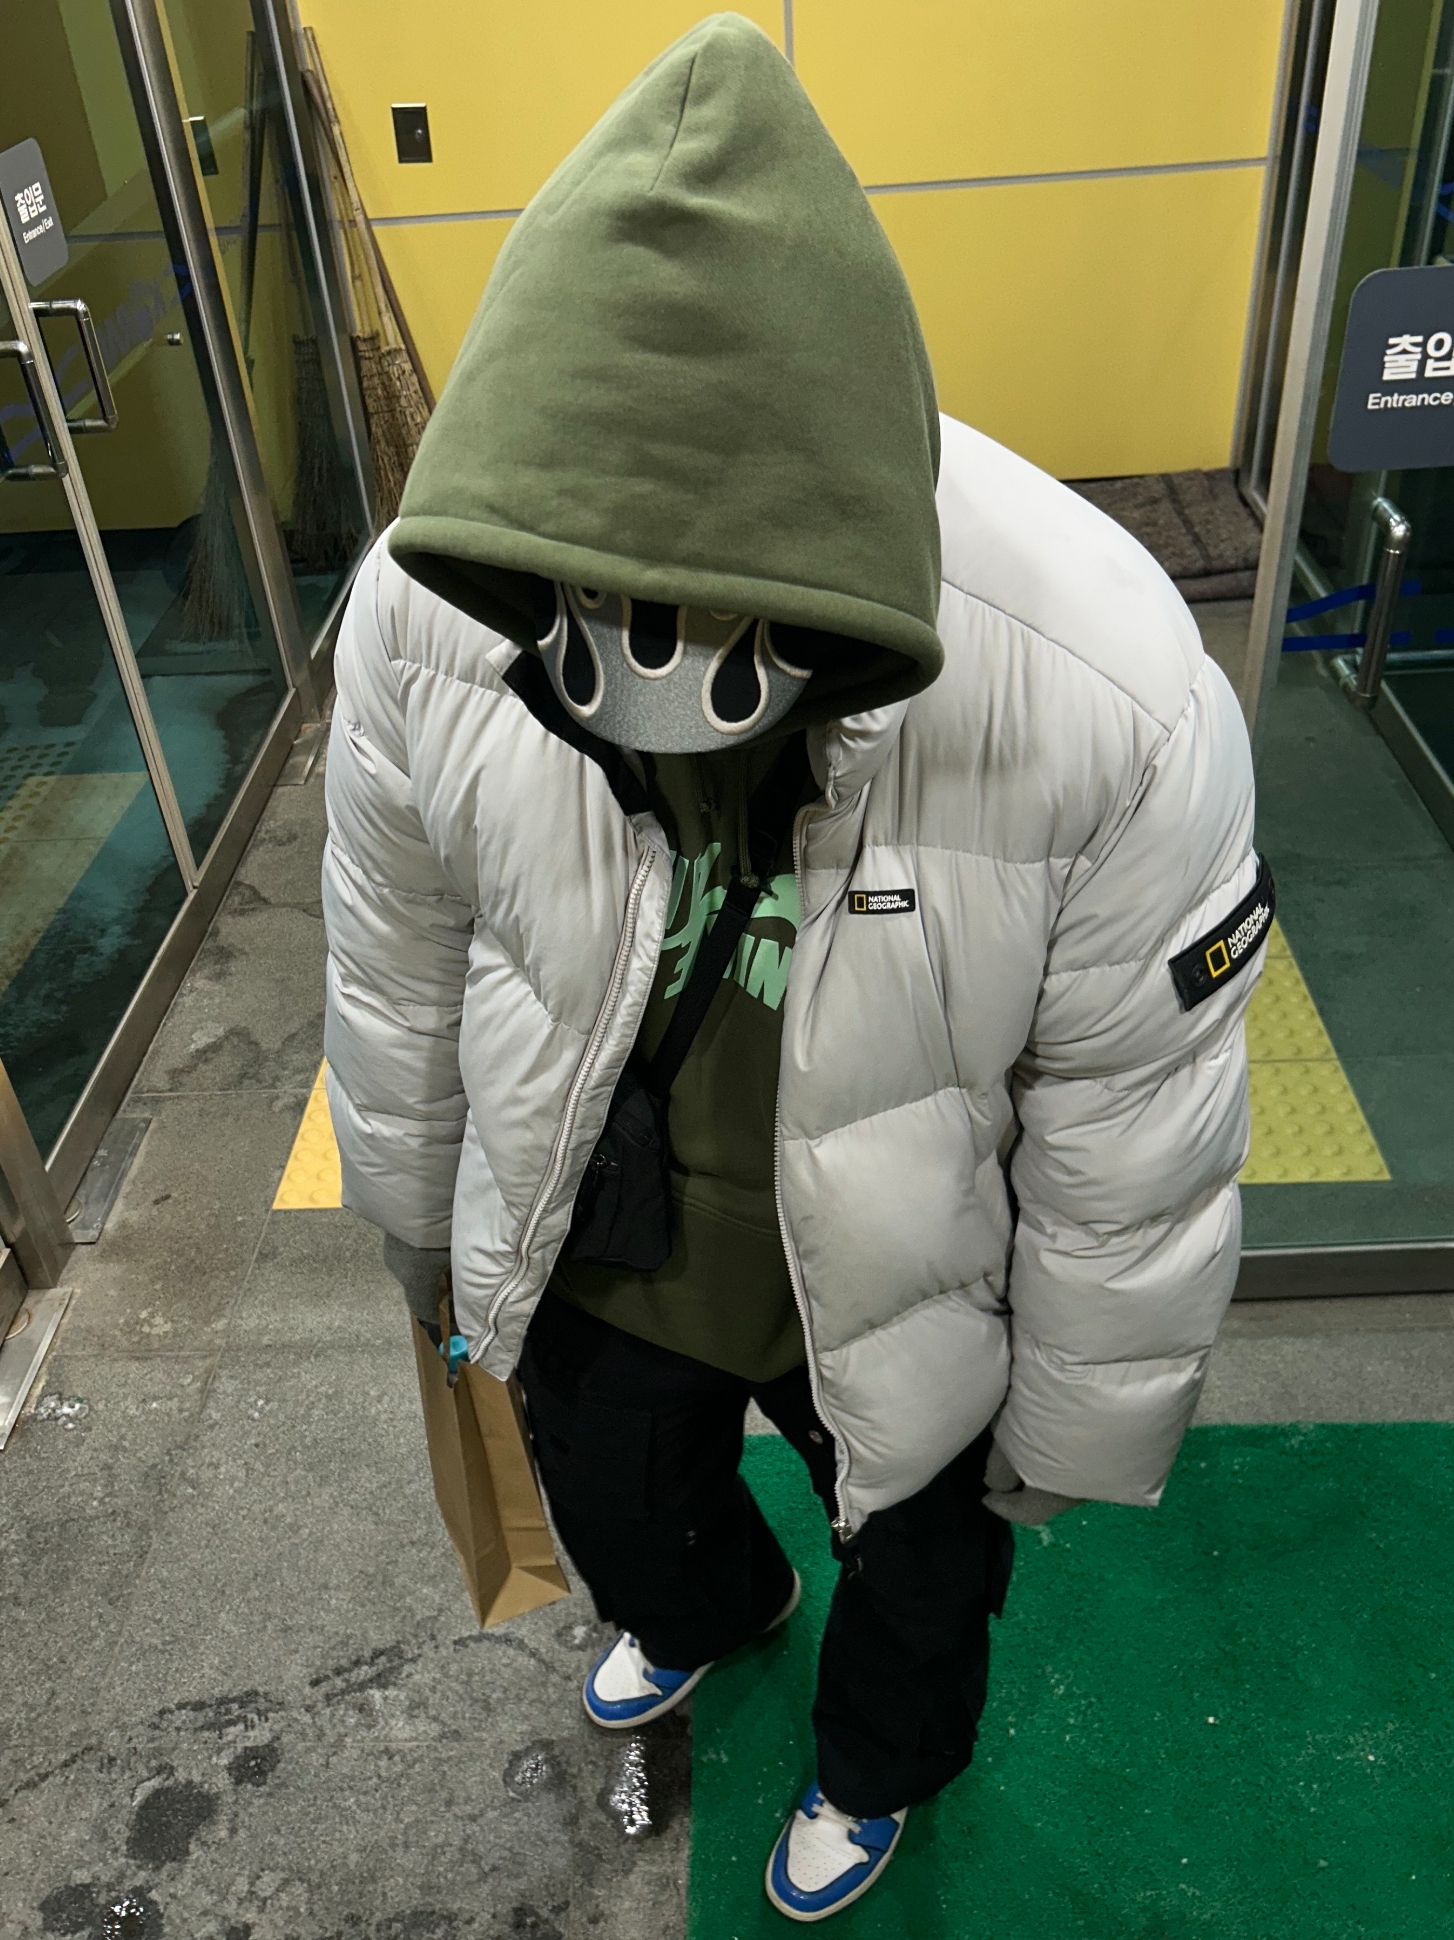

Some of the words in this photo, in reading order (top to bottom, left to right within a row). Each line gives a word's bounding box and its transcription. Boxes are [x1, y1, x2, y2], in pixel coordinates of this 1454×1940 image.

[14, 181, 47, 224] 출입문
[868, 894, 902, 903] NATIONAL
[1227, 902, 1264, 948] NATIONAL
